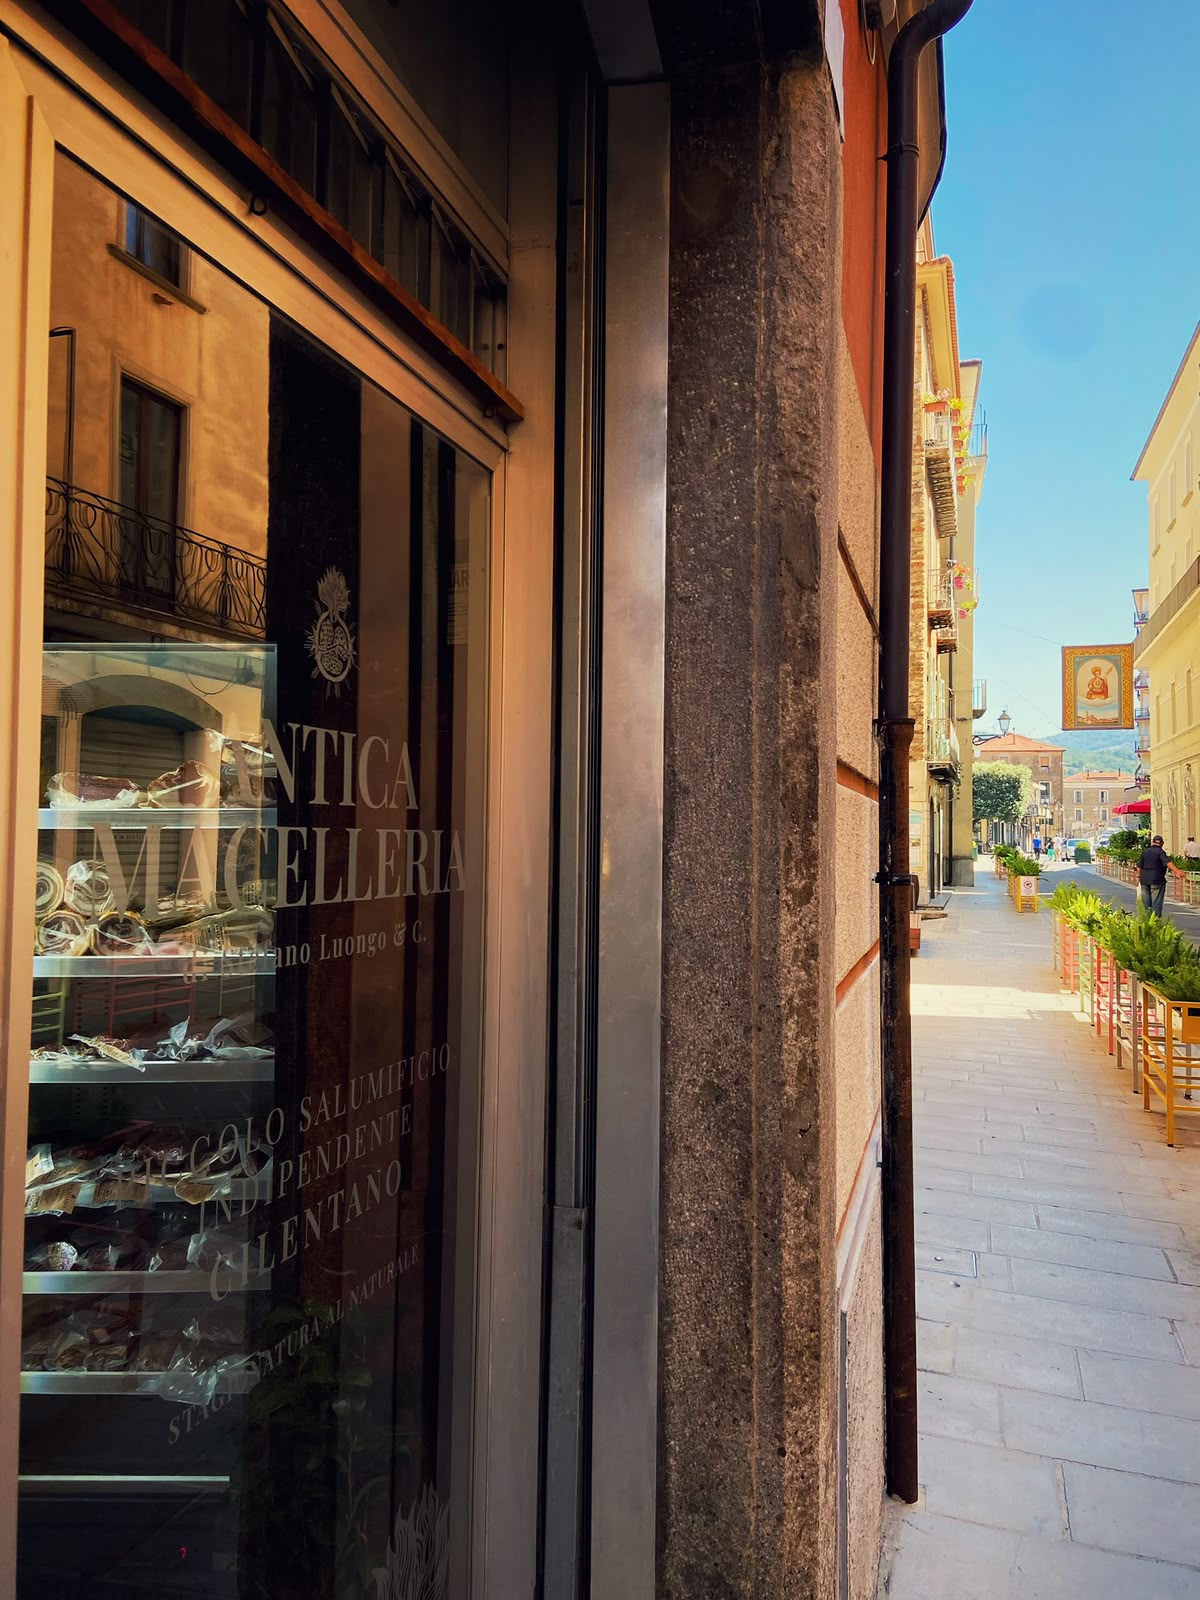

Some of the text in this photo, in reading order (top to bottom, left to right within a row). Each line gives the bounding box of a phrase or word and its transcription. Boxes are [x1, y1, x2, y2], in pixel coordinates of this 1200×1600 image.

[222, 711, 419, 810] ANTICA
[85, 822, 465, 925] MACELLERIA
[319, 931, 386, 961] Luongo
[393, 922, 407, 946] &
[412, 919, 427, 944] C.
[299, 1043, 450, 1132] SALUMIFICIO
[198, 1103, 413, 1235] INDIPENDENTE
[209, 1159, 402, 1302] CILENTANO
[324, 1299, 344, 1329] AL
[350, 1245, 419, 1311] NATURALE
